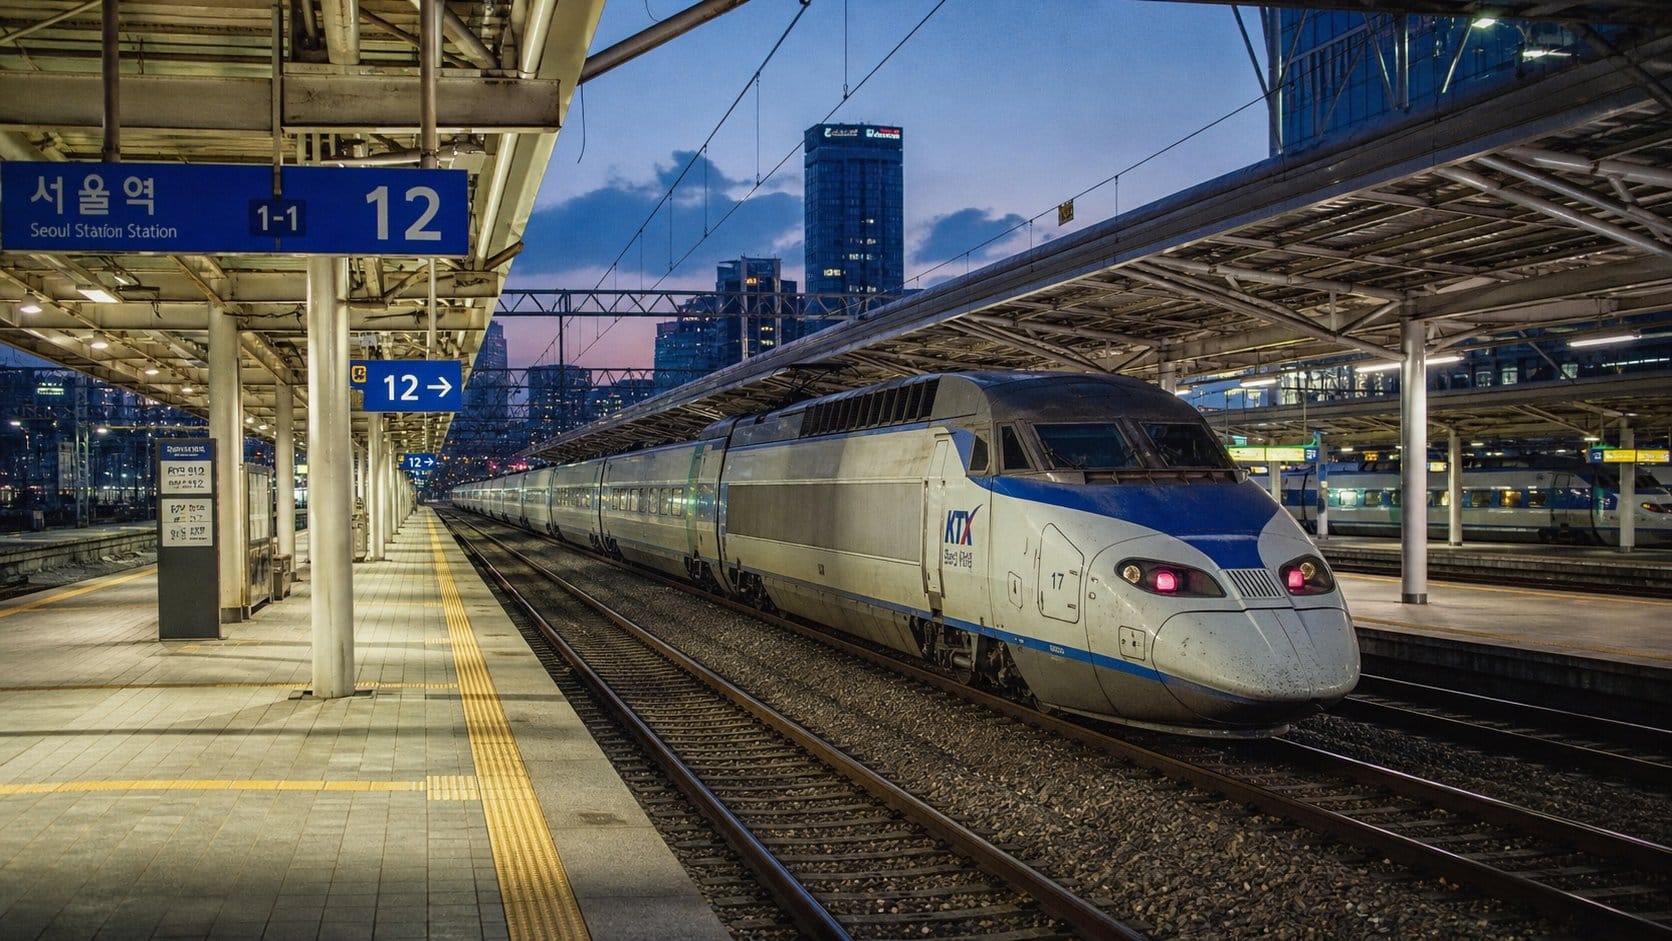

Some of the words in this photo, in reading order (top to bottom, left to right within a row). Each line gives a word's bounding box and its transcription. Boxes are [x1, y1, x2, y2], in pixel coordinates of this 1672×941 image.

[256, 205, 298, 232] 1-1
[365, 185, 442, 241] 12
[30, 222, 70, 238] Seoul
[127, 223, 178, 239] Station
[383, 374, 419, 401] 12
[408, 457, 422, 468] 12
[944, 503, 984, 546] KTX
[1051, 571, 1065, 591] 17
